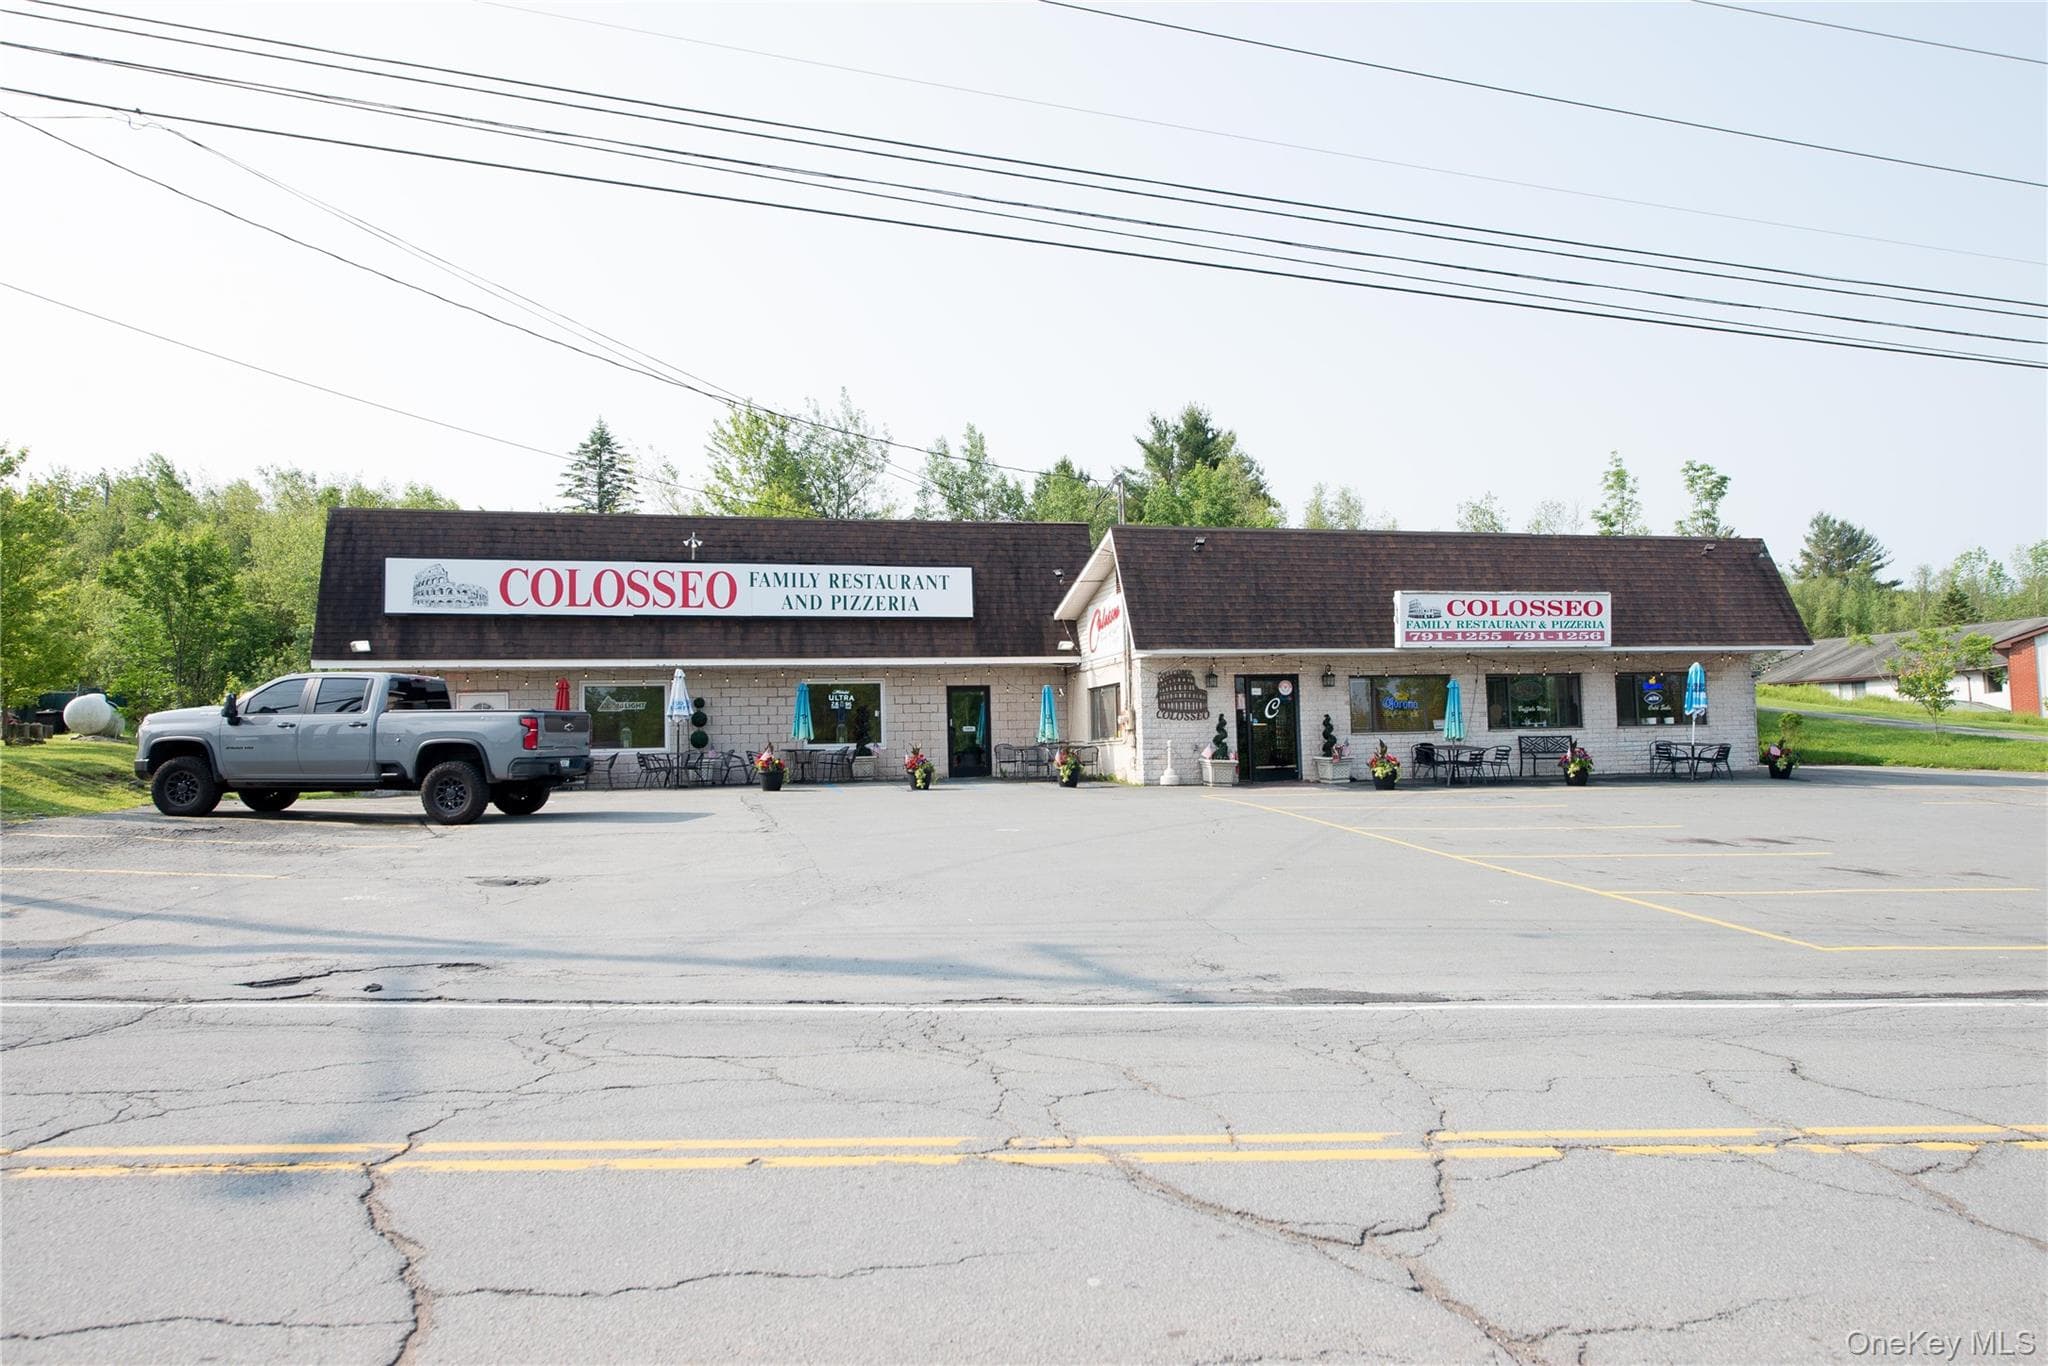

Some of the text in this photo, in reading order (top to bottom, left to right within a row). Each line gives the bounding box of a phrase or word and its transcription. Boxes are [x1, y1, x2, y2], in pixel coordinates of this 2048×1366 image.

[499, 567, 739, 609] COLOSSEO
[748, 571, 950, 591] FAMILY RESTAURANT
[781, 594, 920, 612] AND PIZZERIA
[1446, 599, 1604, 617] COLOSSEO
[1405, 620, 1605, 630] FAMILY RESTAURANT & PIZZERIA
[1409, 631, 1602, 641] 791-1255 791-1256
[828, 694, 855, 702] ULTRA
[1382, 696, 1418, 710] Corona
[624, 702, 646, 710] LIGHT
[1264, 697, 1281, 719] C
[1156, 710, 1210, 721] COLOSSEO
